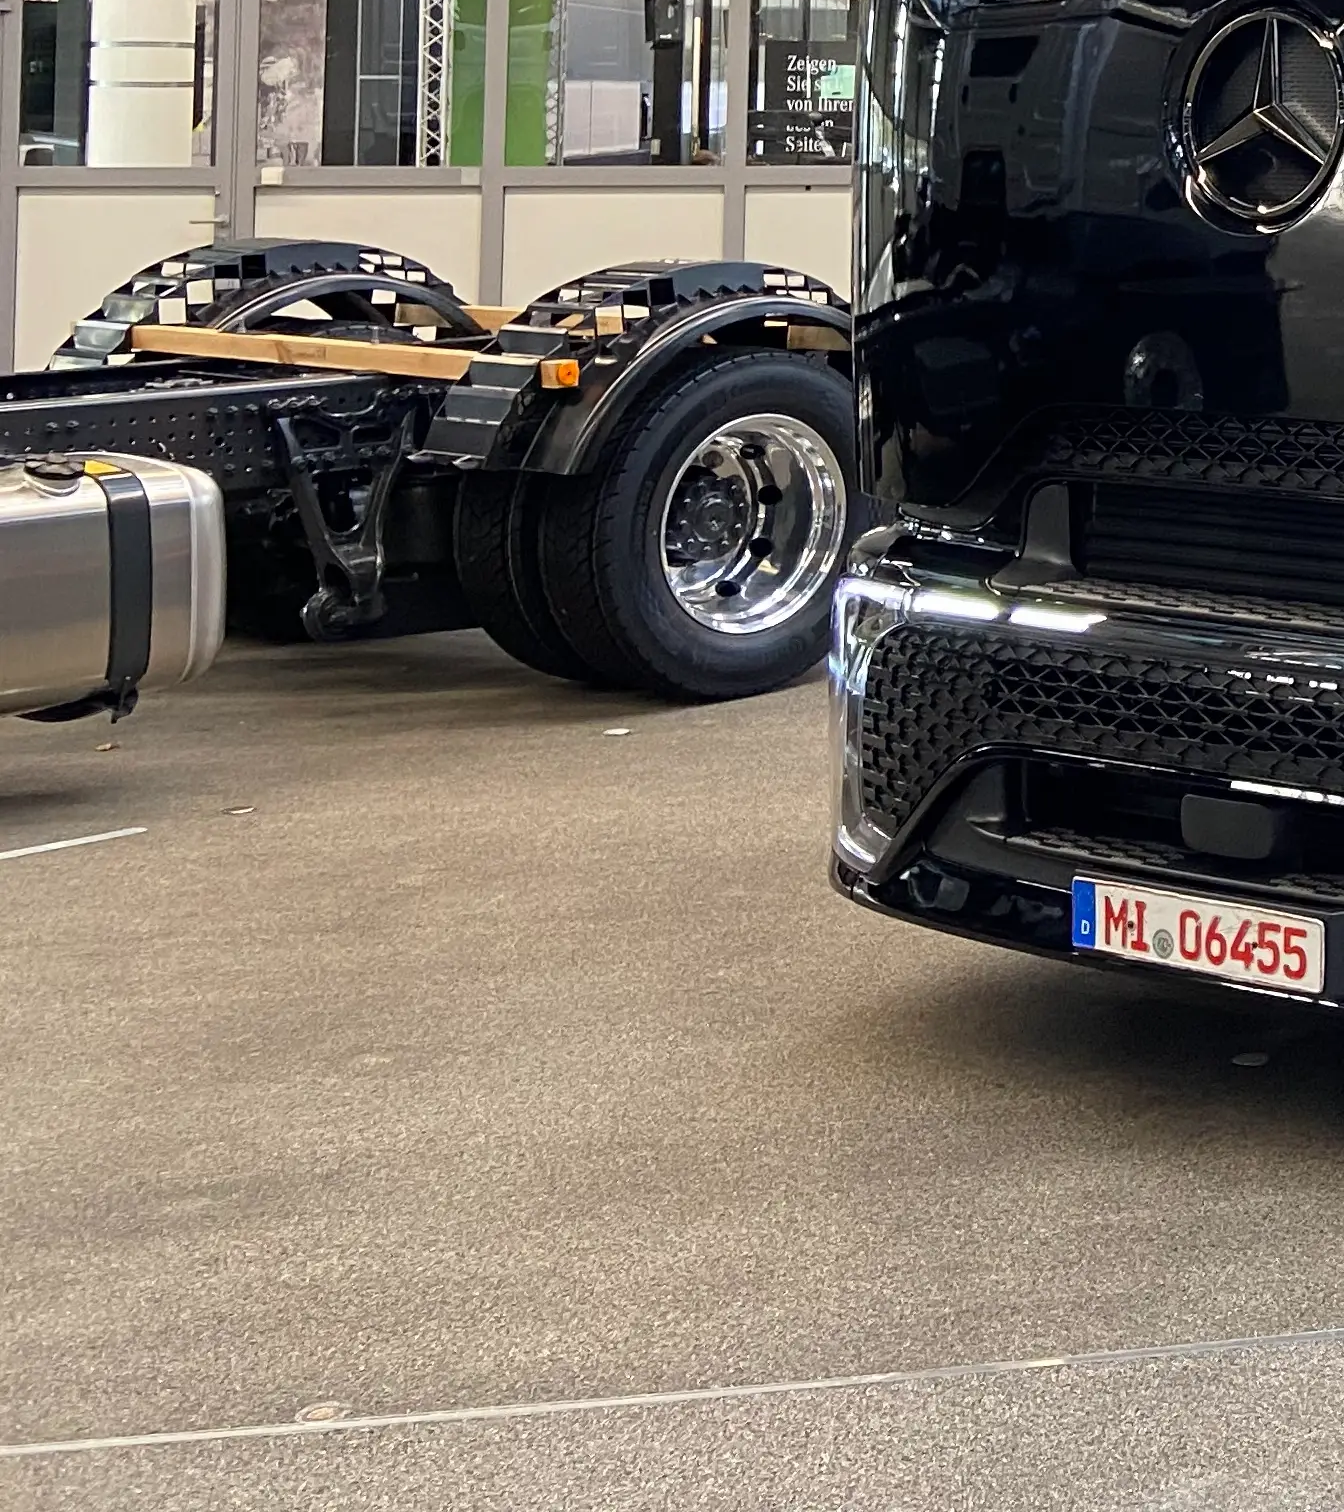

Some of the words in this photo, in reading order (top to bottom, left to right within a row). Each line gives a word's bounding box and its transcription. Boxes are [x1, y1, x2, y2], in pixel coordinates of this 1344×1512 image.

[787, 55, 836, 75] Zeigen
[786, 75, 808, 92] Sie
[787, 99, 813, 111] von
[1081, 919, 1090, 935] D
[1104, 895, 1150, 953] MI
[1179, 910, 1307, 980] 06455
